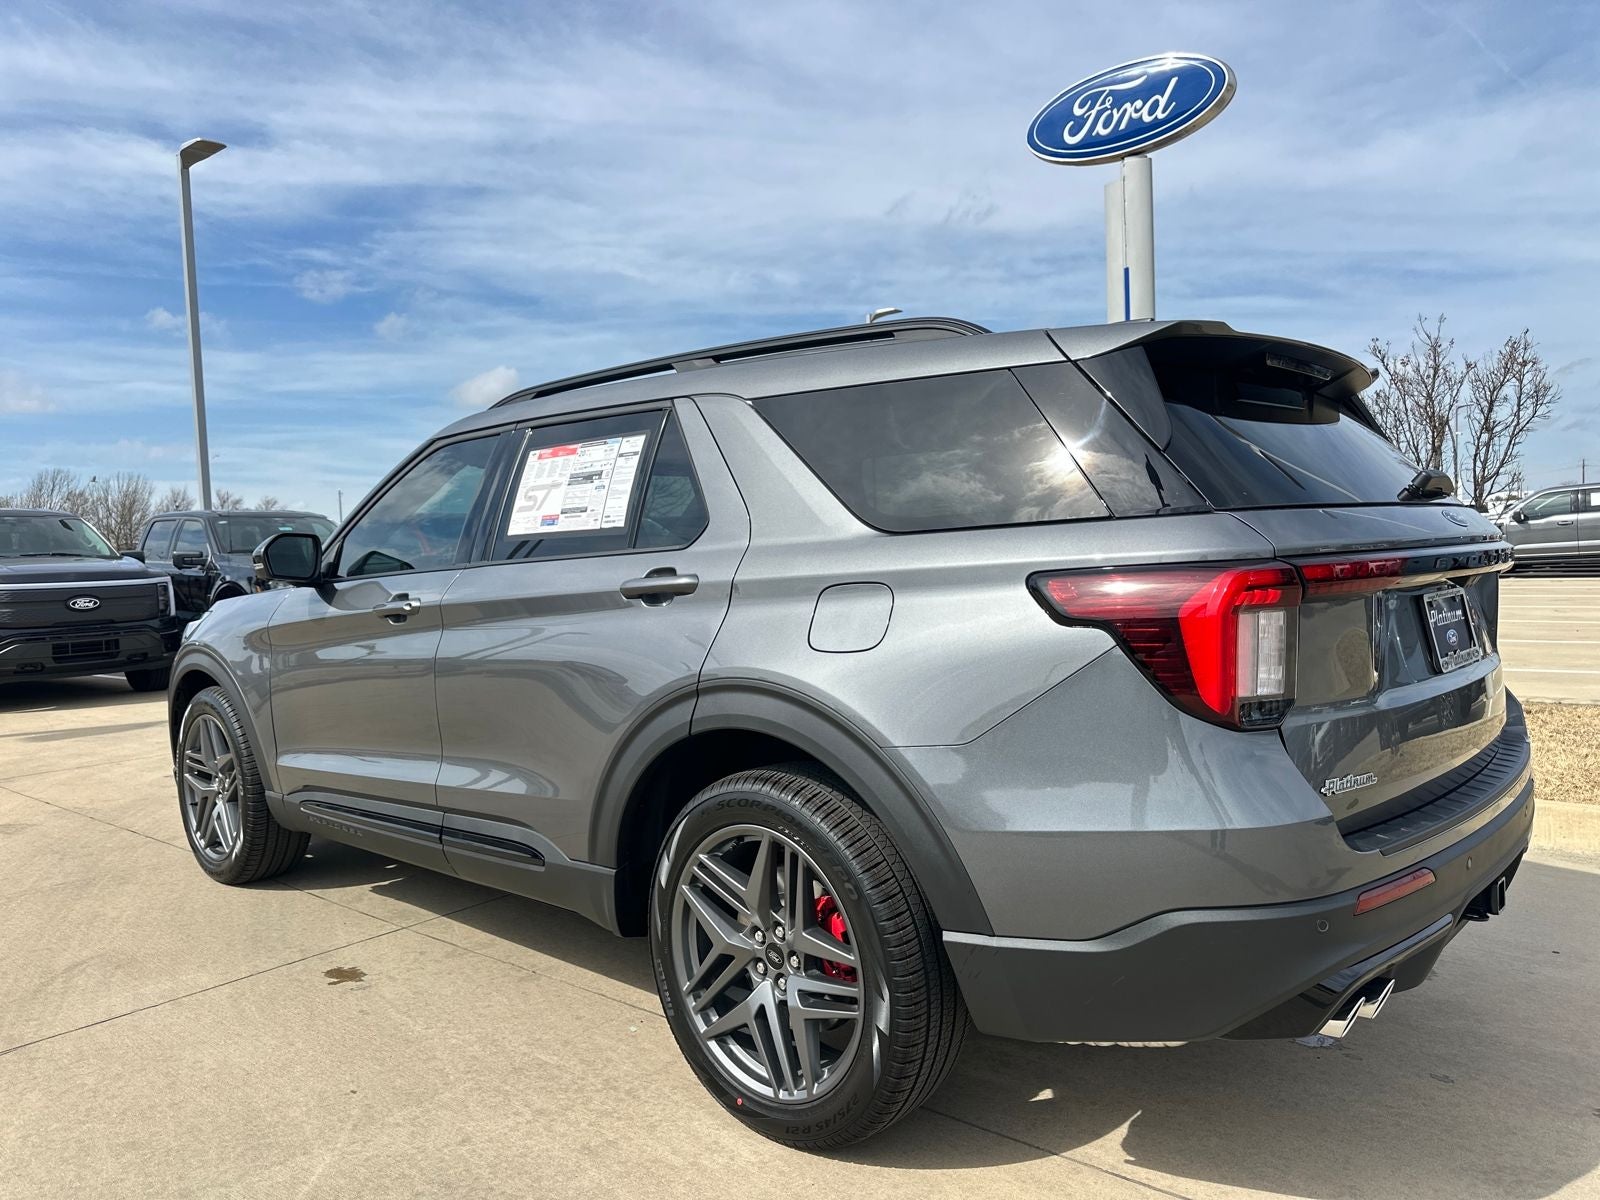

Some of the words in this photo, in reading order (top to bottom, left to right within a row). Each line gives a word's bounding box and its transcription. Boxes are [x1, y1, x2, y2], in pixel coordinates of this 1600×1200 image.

[1063, 75, 1179, 145] Ford
[516, 480, 563, 513] ST
[75, 599, 95, 608] Ford
[1321, 772, 1378, 796] Platinum
[785, 1125, 811, 1135] R21
